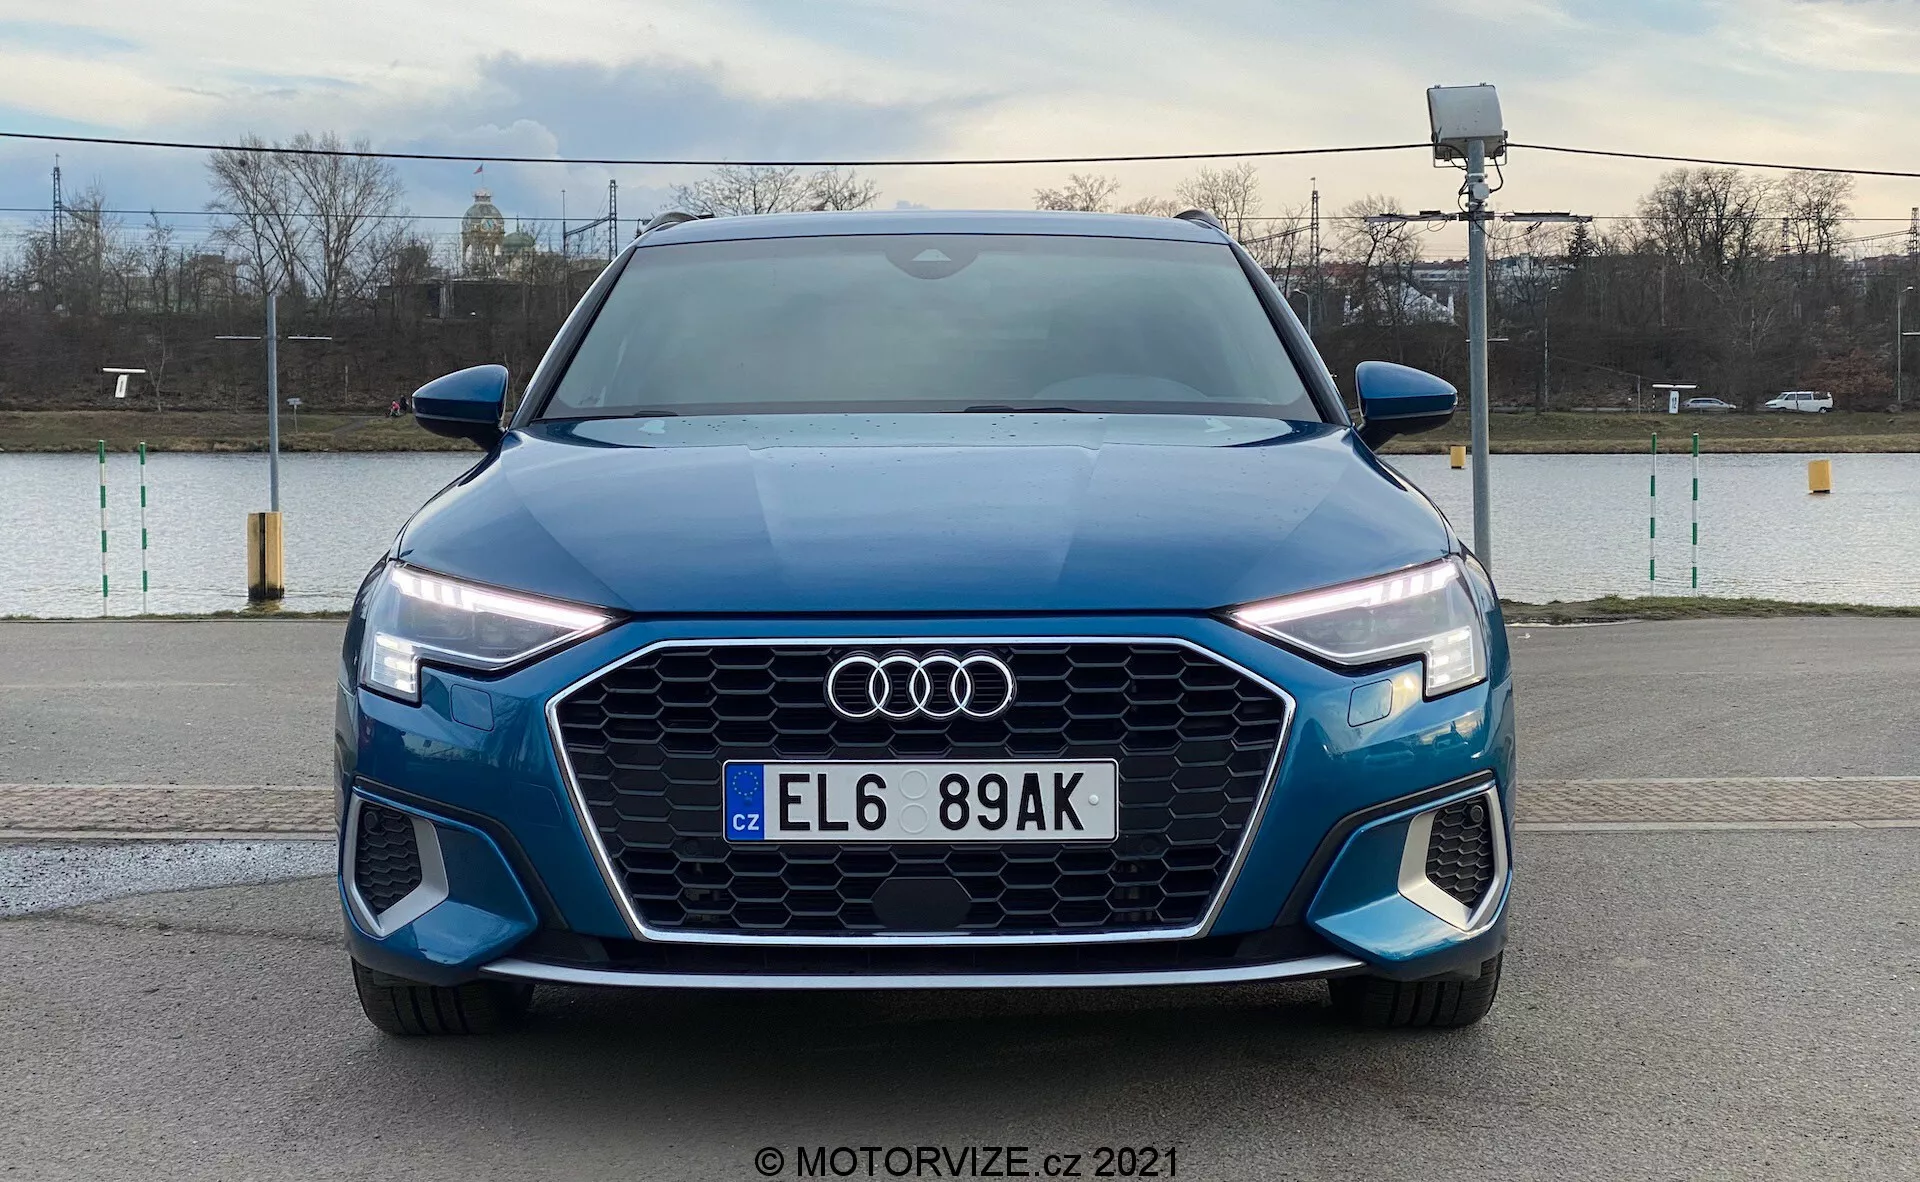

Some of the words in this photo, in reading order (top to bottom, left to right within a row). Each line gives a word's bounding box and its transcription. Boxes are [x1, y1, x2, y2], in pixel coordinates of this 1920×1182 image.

[779, 773, 887, 831] EL6
[939, 772, 1084, 831] 89AK
[732, 813, 760, 831] CZ
